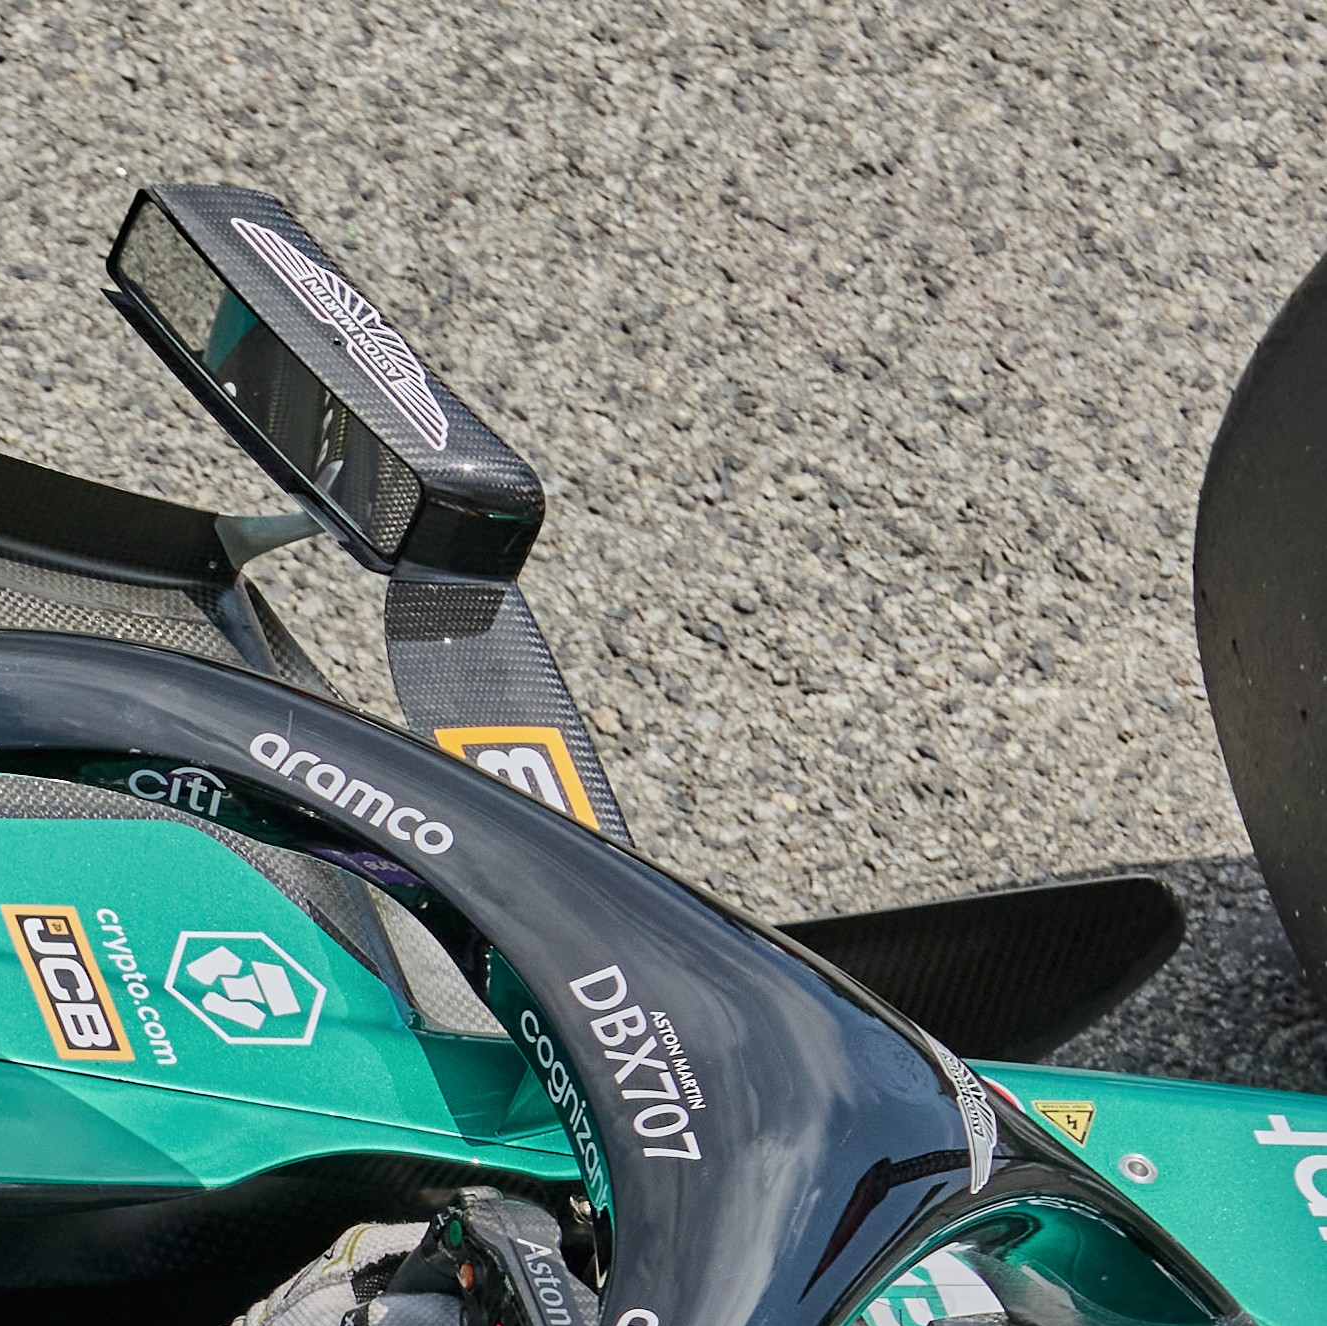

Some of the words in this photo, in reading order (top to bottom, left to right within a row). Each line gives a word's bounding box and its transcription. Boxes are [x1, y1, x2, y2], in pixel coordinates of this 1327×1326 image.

[304, 279, 361, 333] MARTIN
[353, 333, 403, 378] ASTON
[128, 766, 226, 817] citi
[249, 732, 454, 855] aramco
[23, 917, 113, 1048] JCB
[96, 908, 178, 1065] crypto.com
[521, 1010, 609, 1205] cognizant
[569, 965, 701, 1160] DBX707
[650, 1010, 681, 1056] ASTON
[672, 1057, 706, 1110] MARTIN
